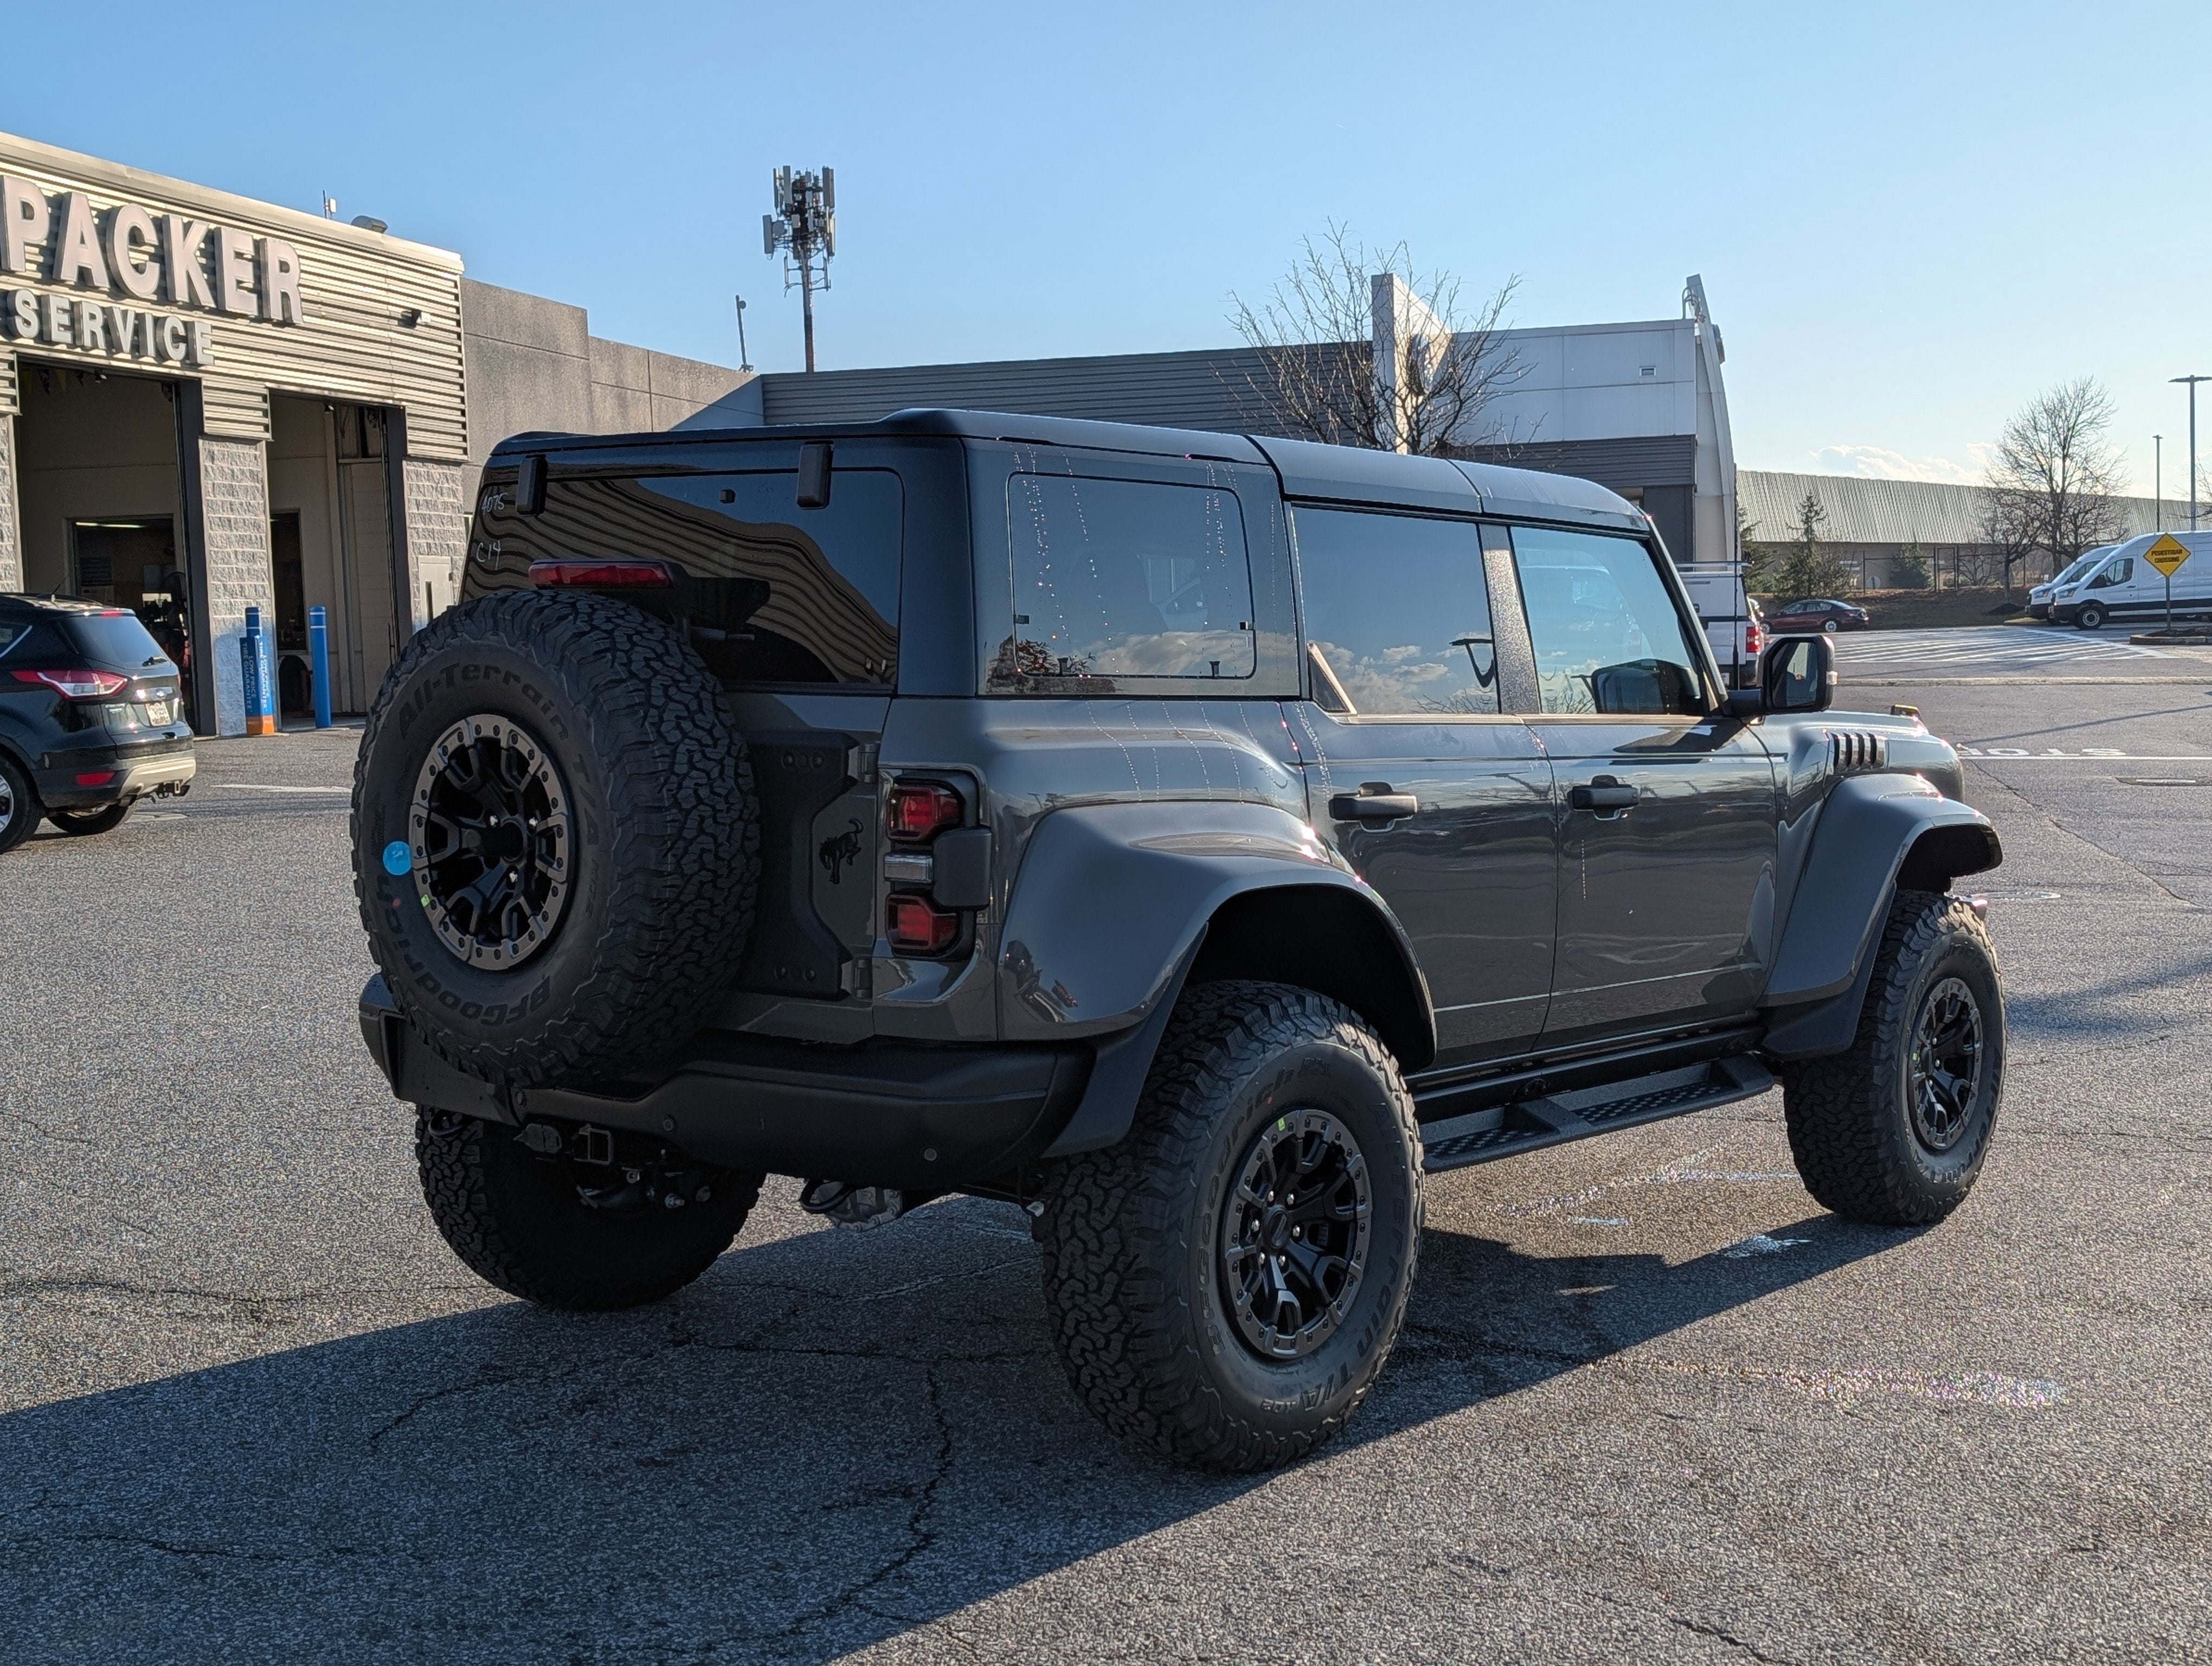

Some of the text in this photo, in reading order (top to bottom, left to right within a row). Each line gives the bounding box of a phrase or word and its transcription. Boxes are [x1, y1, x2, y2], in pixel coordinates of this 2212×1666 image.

[1, 175, 305, 325] PACKER
[7, 288, 216, 367] SERVICE
[481, 492, 509, 515] 4075
[476, 540, 501, 571] C14
[398, 662, 569, 740] All-Terrain
[377, 874, 551, 1026] BFGoodrich
[1198, 1067, 1296, 1357] BFGoodrich
